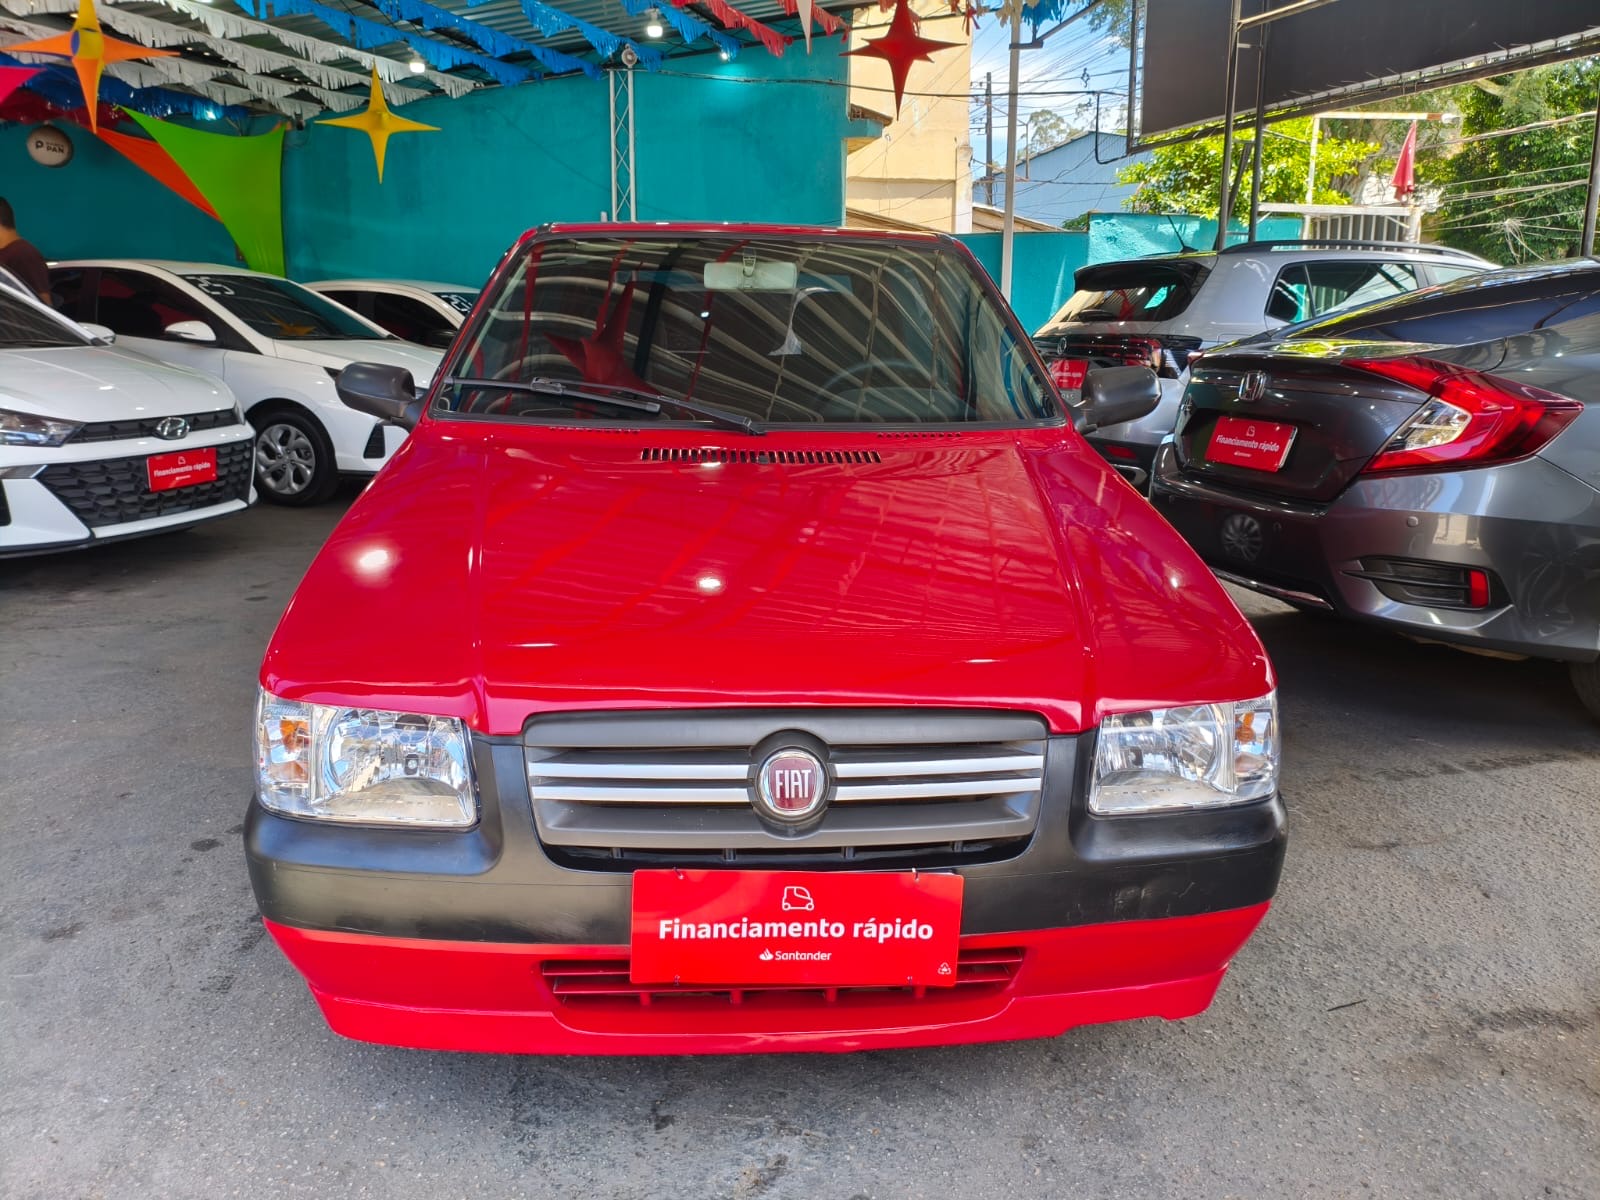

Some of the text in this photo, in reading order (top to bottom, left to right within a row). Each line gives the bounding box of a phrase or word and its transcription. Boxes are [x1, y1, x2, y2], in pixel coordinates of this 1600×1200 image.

[1216, 434, 1259, 449] Financiamento
[775, 769, 812, 799] FIAT
[658, 917, 934, 944] Financiamento rápido
[774, 949, 832, 962] Santander
